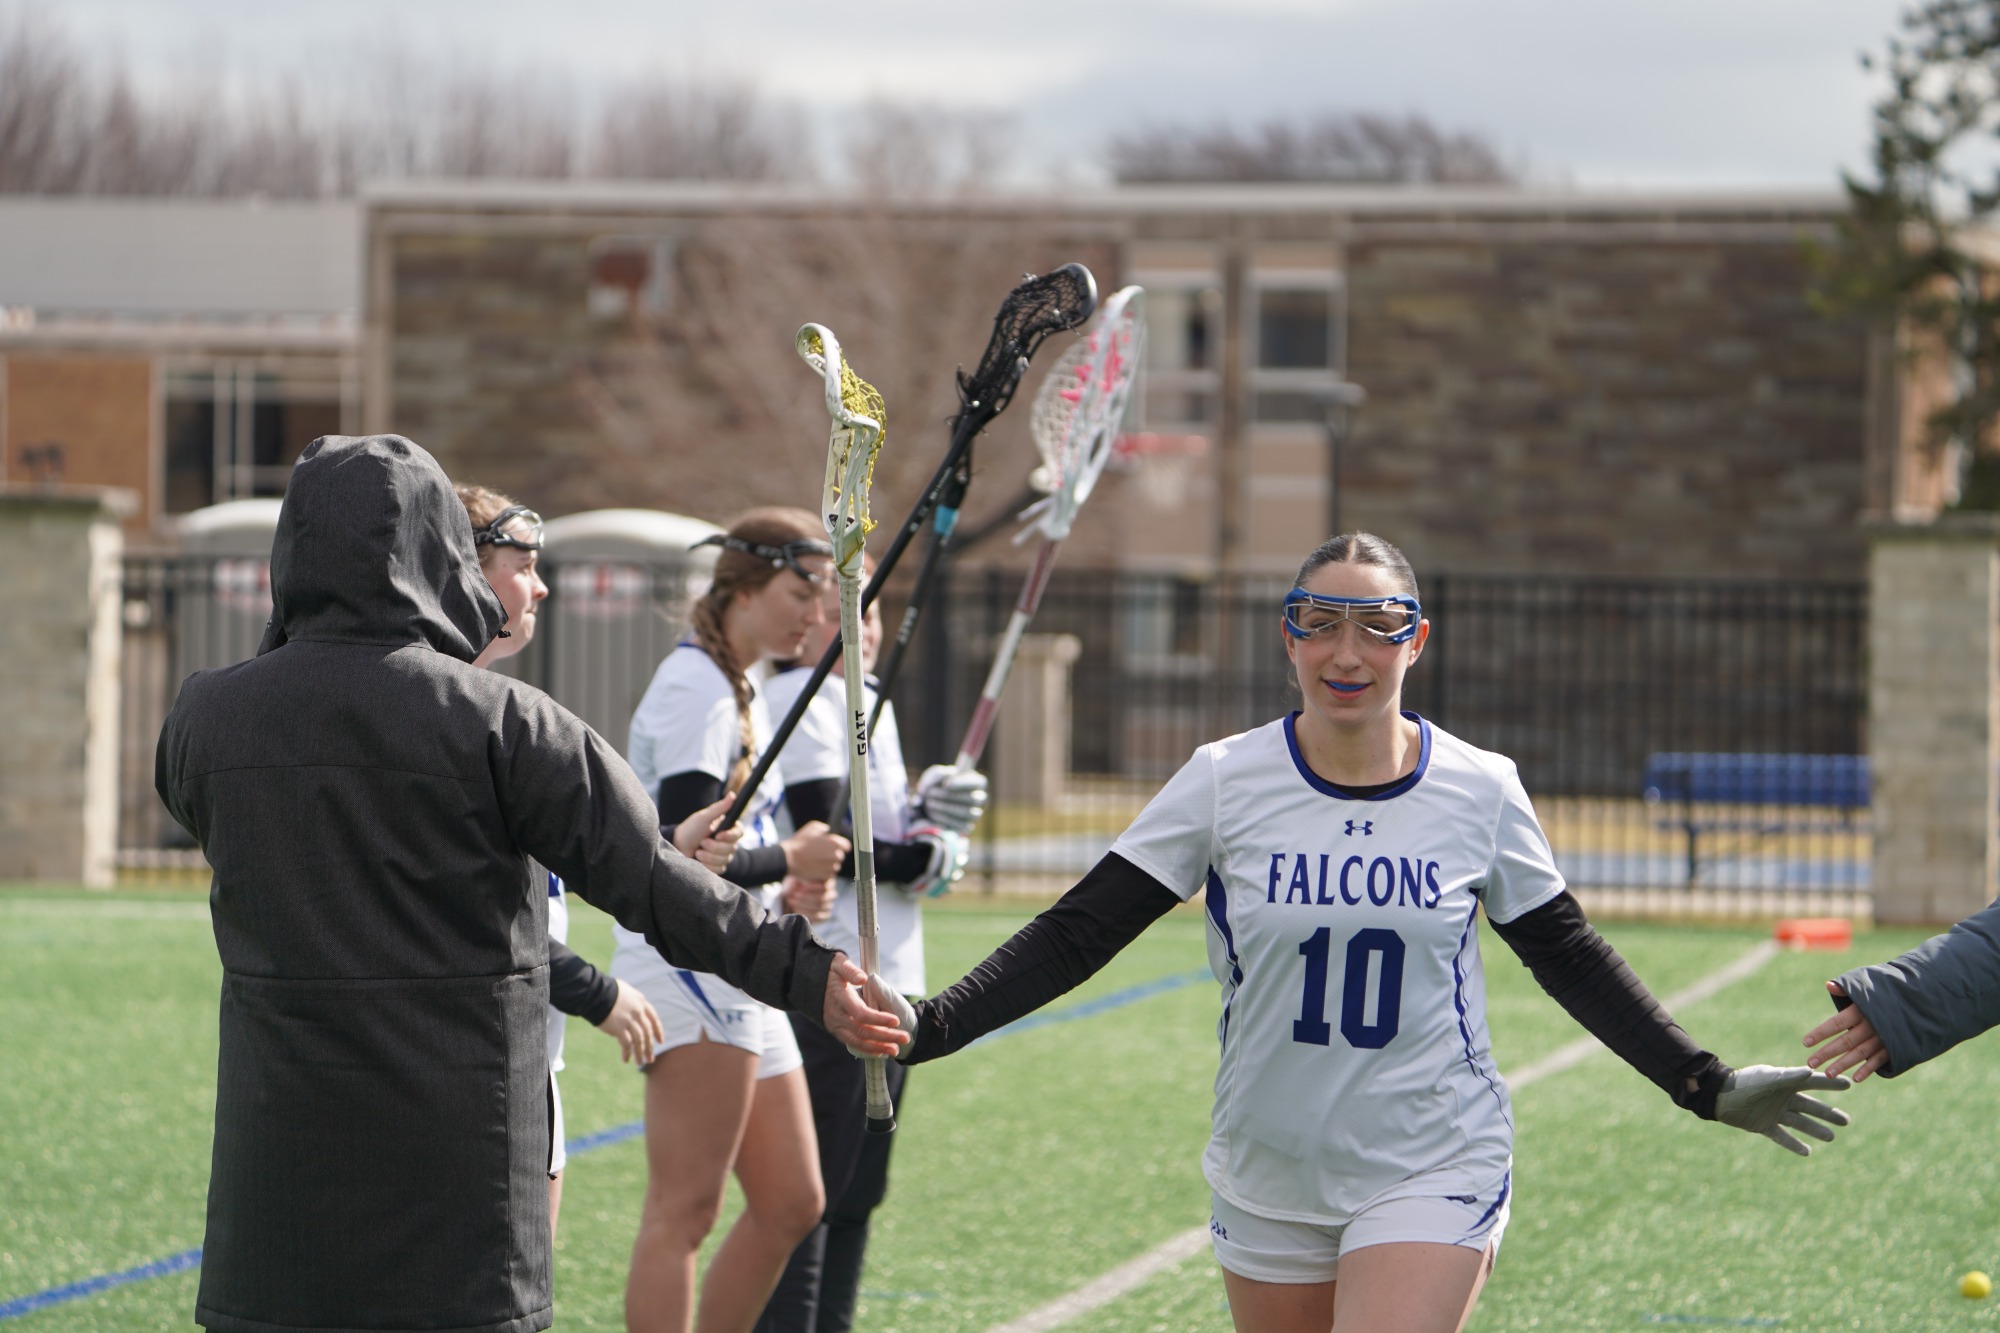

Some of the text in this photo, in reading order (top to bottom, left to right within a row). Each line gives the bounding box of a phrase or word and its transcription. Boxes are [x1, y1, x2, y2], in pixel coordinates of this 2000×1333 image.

[855, 710, 867, 756] GAIT
[1267, 853, 1443, 909] FALCONS
[1293, 927, 1406, 1049] 10
